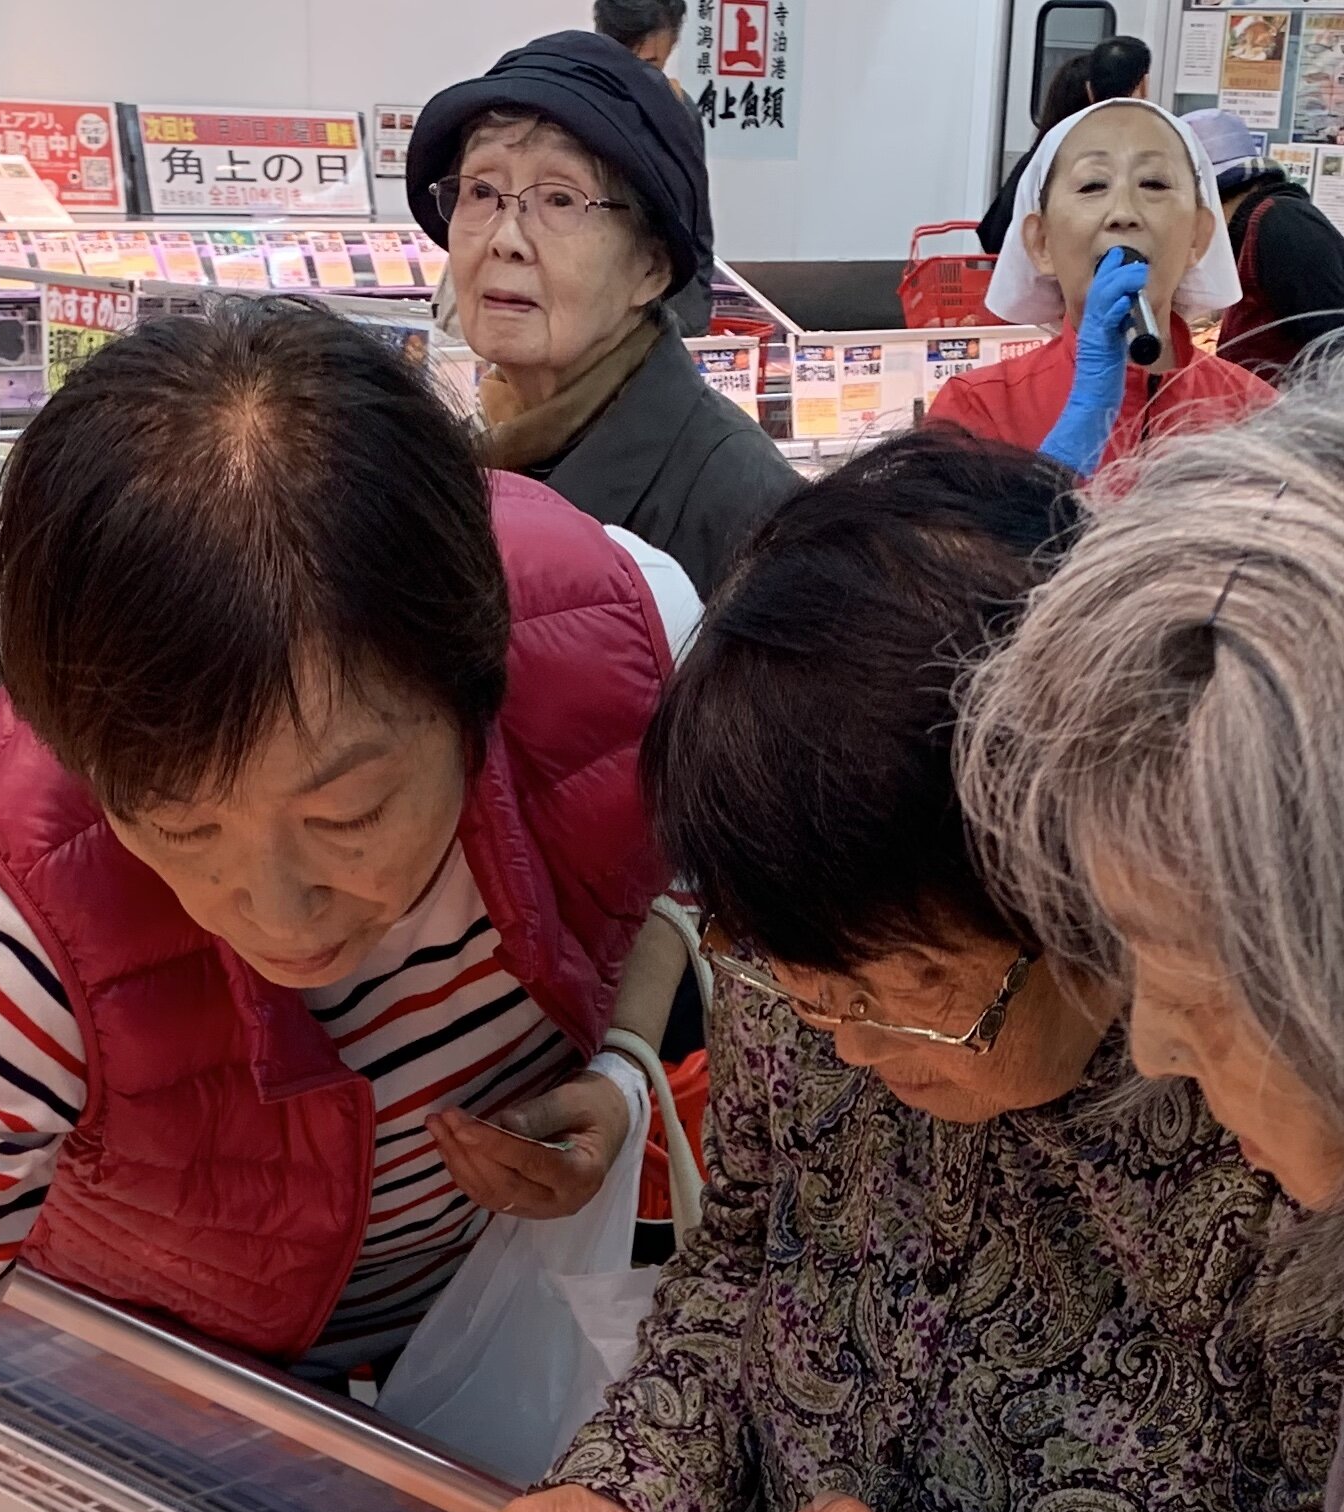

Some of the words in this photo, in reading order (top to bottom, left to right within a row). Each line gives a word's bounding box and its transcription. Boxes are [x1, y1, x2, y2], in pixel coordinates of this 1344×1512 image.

[723, 7, 763, 69] 上
[696, 79, 785, 130] 角上魚類
[161, 147, 348, 185] 角上の日
